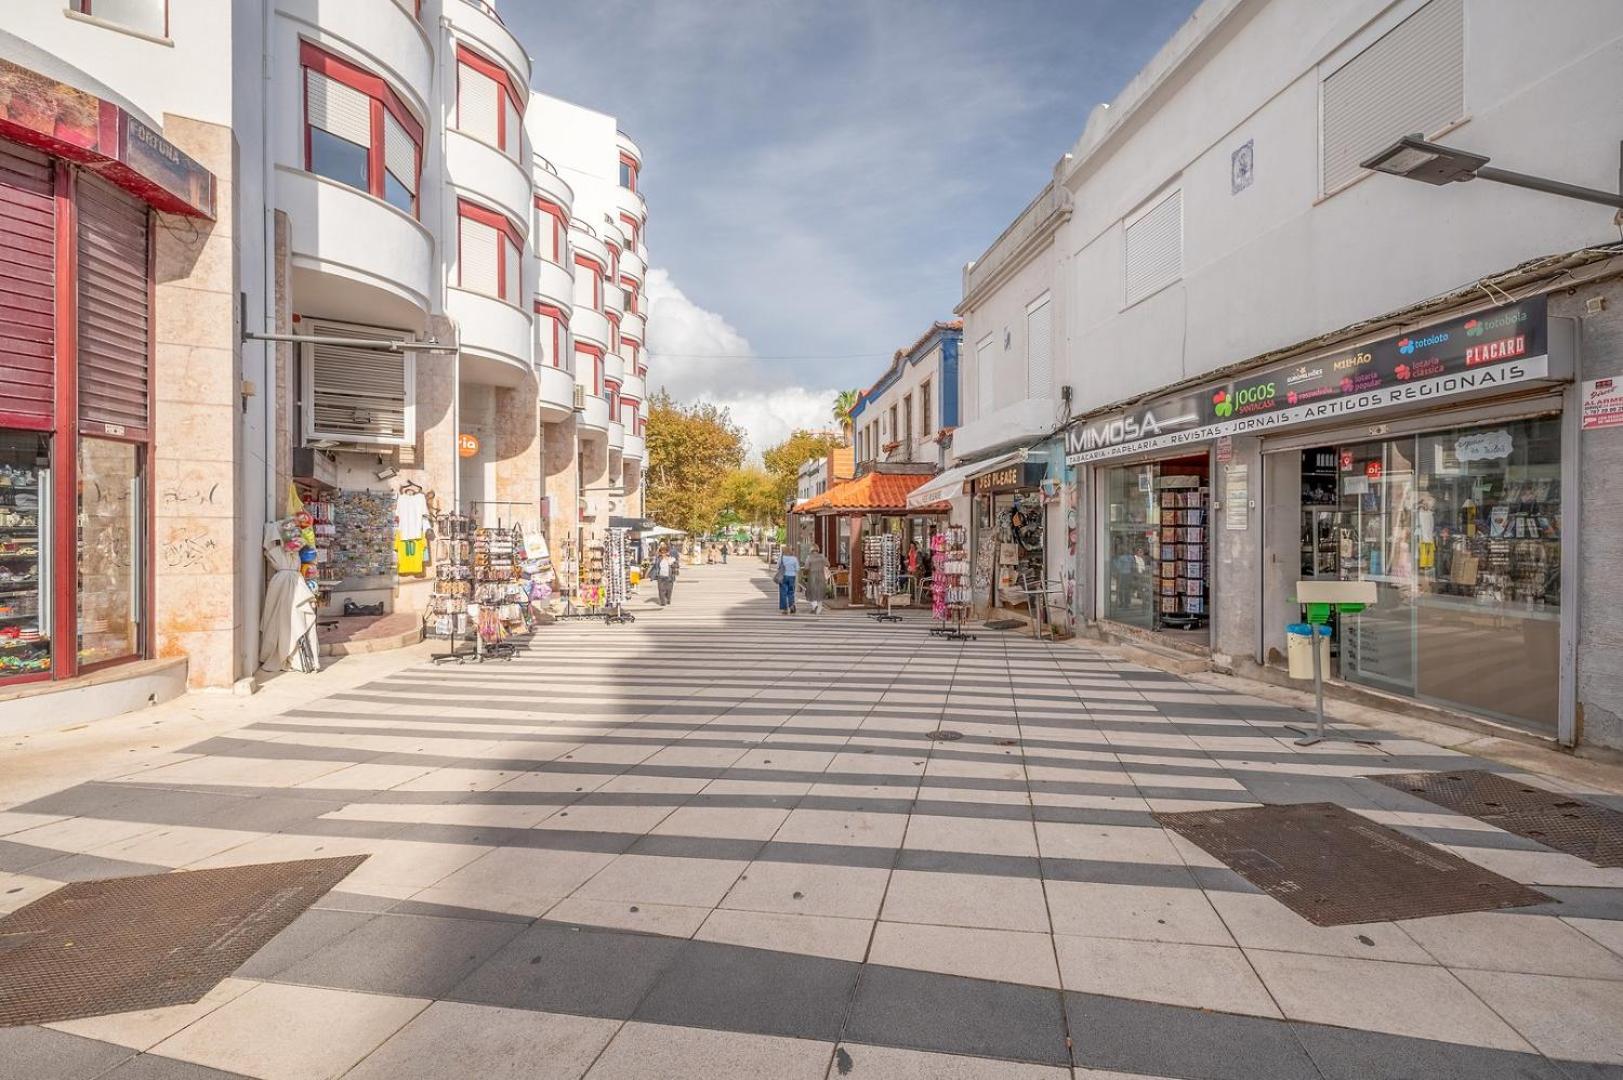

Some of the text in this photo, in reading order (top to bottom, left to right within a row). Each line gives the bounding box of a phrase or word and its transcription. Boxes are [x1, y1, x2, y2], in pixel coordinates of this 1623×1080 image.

[1484, 311, 1527, 330] totobola
[1415, 332, 1448, 349] totoloto
[1465, 336, 1525, 363] PLACARD
[1235, 382, 1276, 411] JOGOS
[1069, 365, 1525, 463] TABACARIA PAPELARIA REVISTAS JORNAIS ARTIGOS REGIONAIS
[1070, 410, 1157, 454] MIMOSA
[992, 469, 1017, 486] PLEASE
